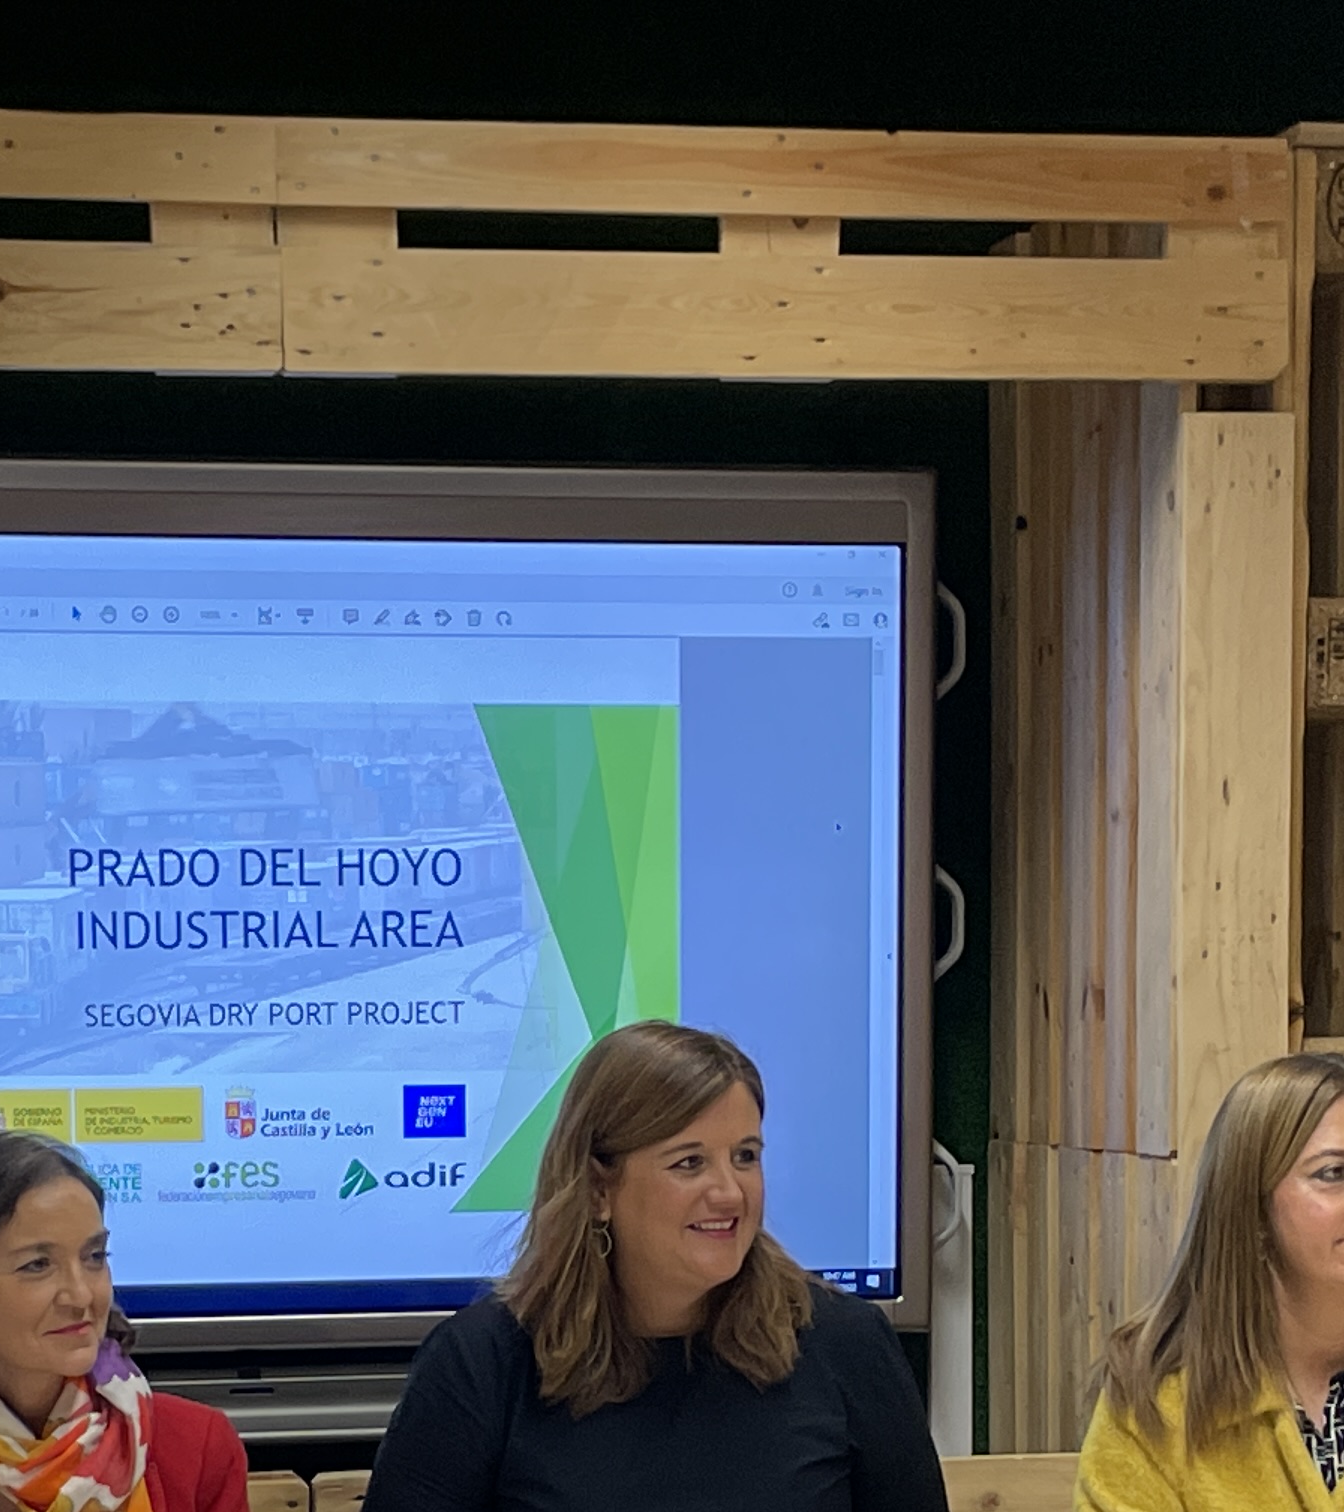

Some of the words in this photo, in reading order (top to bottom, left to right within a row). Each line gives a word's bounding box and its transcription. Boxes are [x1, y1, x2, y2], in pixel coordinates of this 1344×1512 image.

[68, 848, 221, 888] PRADO
[240, 847, 321, 887] DEL
[337, 847, 462, 887] HOYO
[77, 910, 339, 950] INDUSTRIAL
[349, 909, 465, 949] AREA
[84, 1003, 201, 1028] SEGOVIA
[208, 1002, 257, 1027] DRY
[269, 1001, 339, 1026] PORT
[346, 1000, 465, 1025] PROJECT
[84, 1107, 136, 1116] MINISTERIO
[260, 1107, 305, 1123] Junta
[309, 1107, 331, 1121] de
[260, 1122, 318, 1138] Castilla
[321, 1125, 332, 1140] y
[335, 1121, 375, 1136] León
[222, 1160, 281, 1189] fes
[384, 1162, 467, 1189] adif
